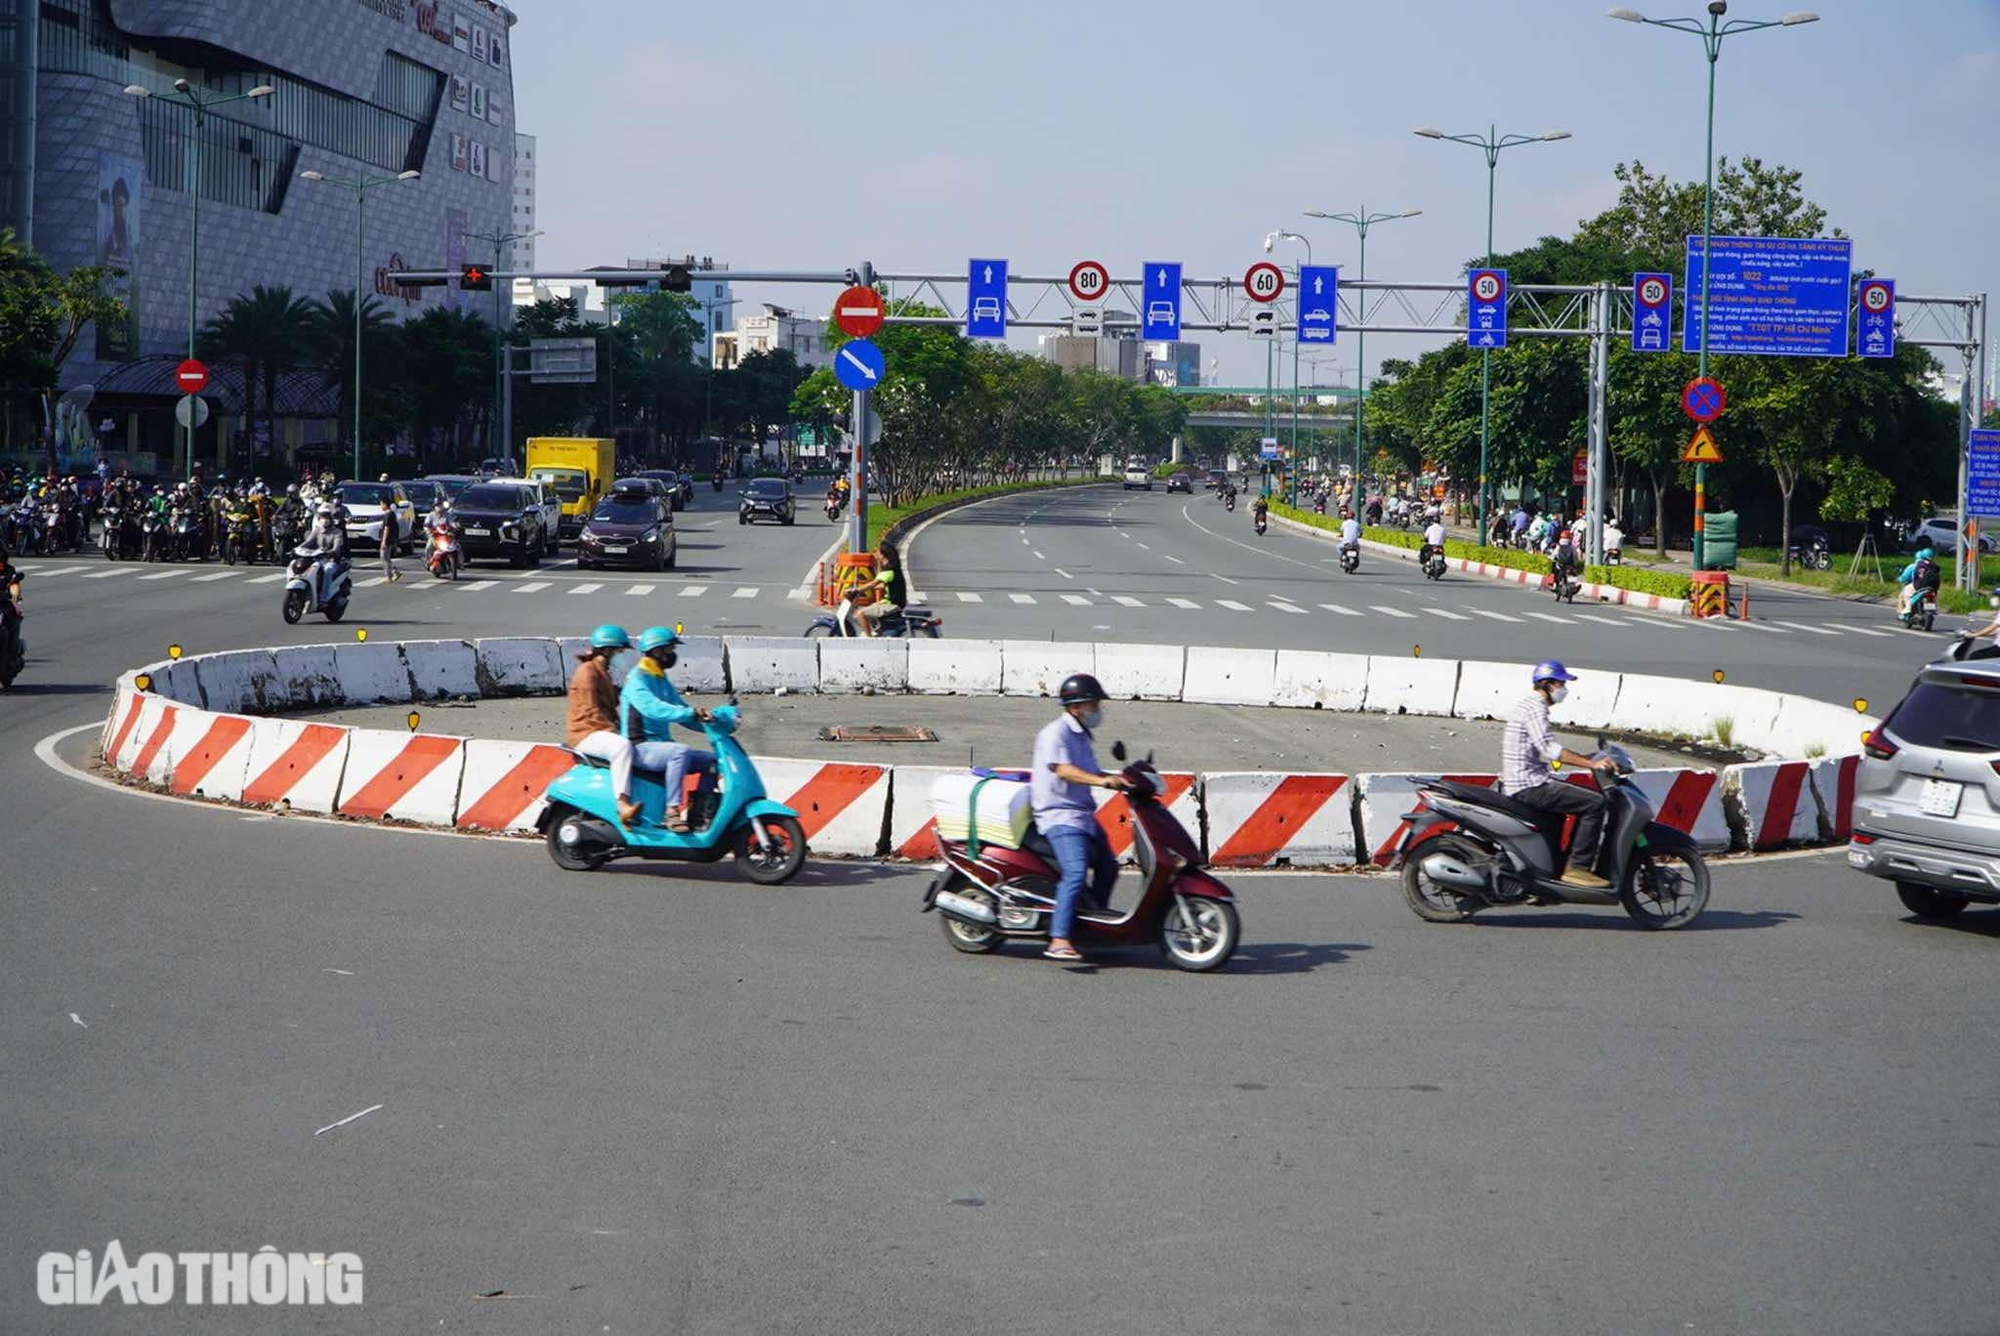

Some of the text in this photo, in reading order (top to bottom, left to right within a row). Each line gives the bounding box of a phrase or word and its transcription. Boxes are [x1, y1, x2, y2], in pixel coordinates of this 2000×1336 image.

[1081, 272, 1098, 287] 80
[1256, 275, 1274, 291] 60
[1481, 280, 1494, 295] 50
[1646, 284, 1661, 299] 50
[1870, 291, 1884, 305] 50
